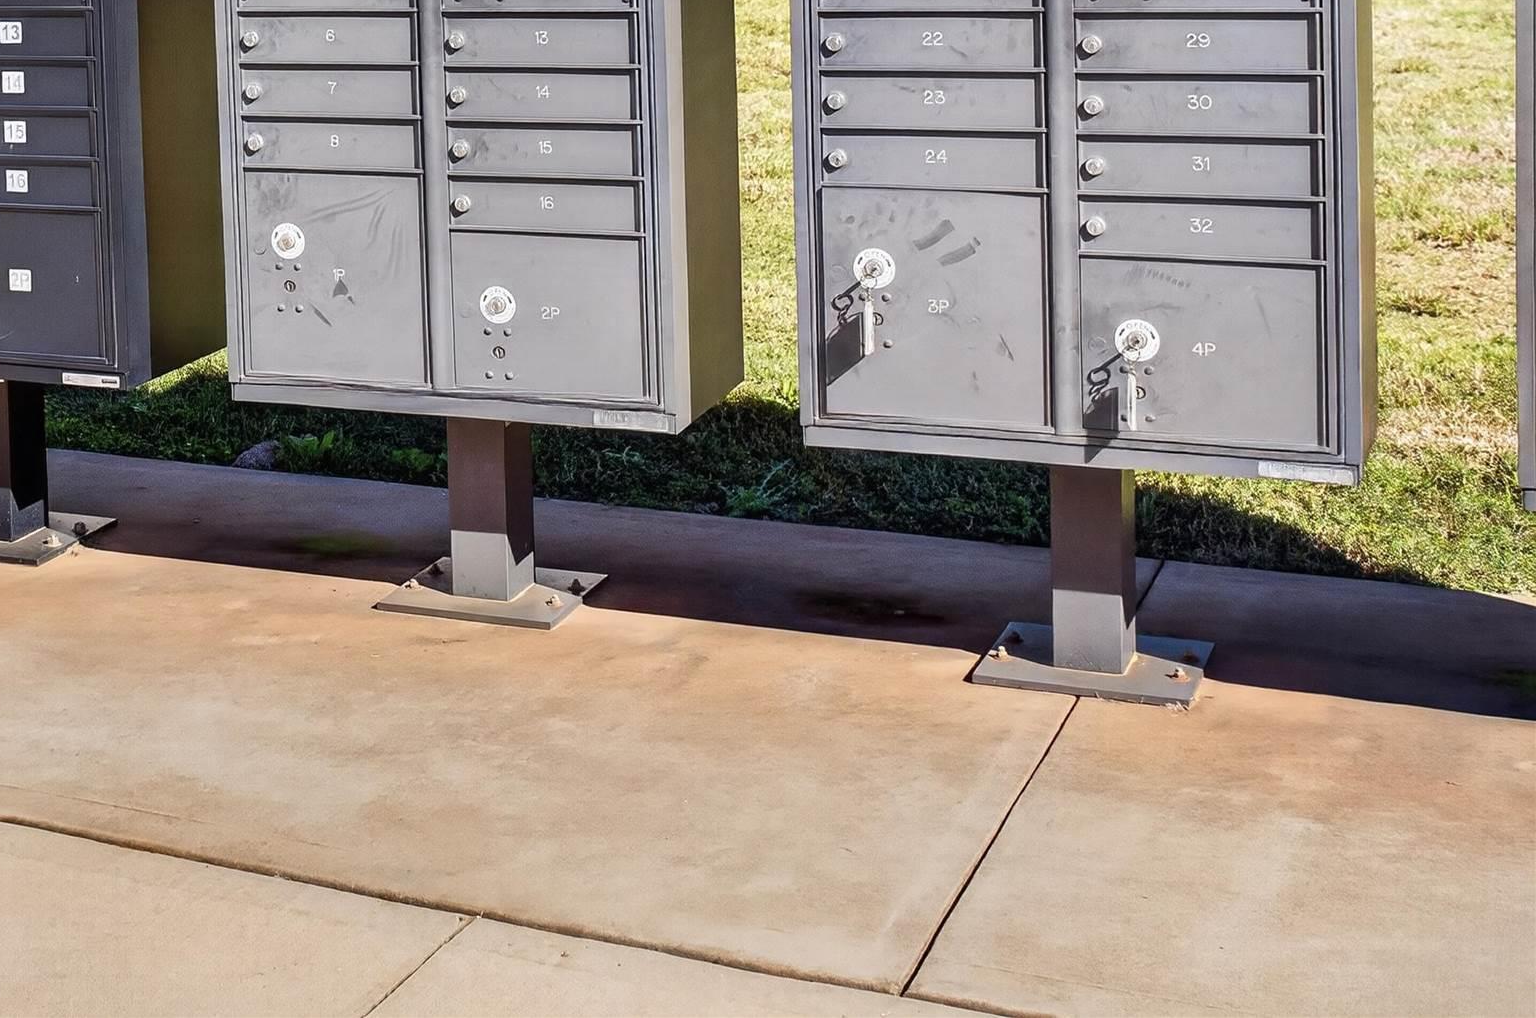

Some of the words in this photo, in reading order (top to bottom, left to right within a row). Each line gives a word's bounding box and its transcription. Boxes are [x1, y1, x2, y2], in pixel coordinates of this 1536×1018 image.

[2, 25, 20, 41] 13
[325, 29, 335, 42] 6
[922, 31, 944, 46] 22
[1186, 32, 1211, 48] 29
[7, 75, 21, 89] 14
[327, 81, 337, 95] 7
[535, 85, 551, 99] 14
[1187, 94, 1213, 110] 30
[7, 124, 24, 139] 15
[538, 140, 553, 154] 15
[925, 149, 948, 164] 24
[1192, 156, 1210, 172] 31
[8, 174, 26, 189] 16
[539, 196, 554, 210] 16
[1190, 218, 1214, 234] 32
[11, 272, 29, 288] 2P
[332, 268, 346, 283] 1P
[540, 306, 561, 320] 2P
[927, 298, 950, 314] 3P
[1191, 341, 1217, 357] 4P
